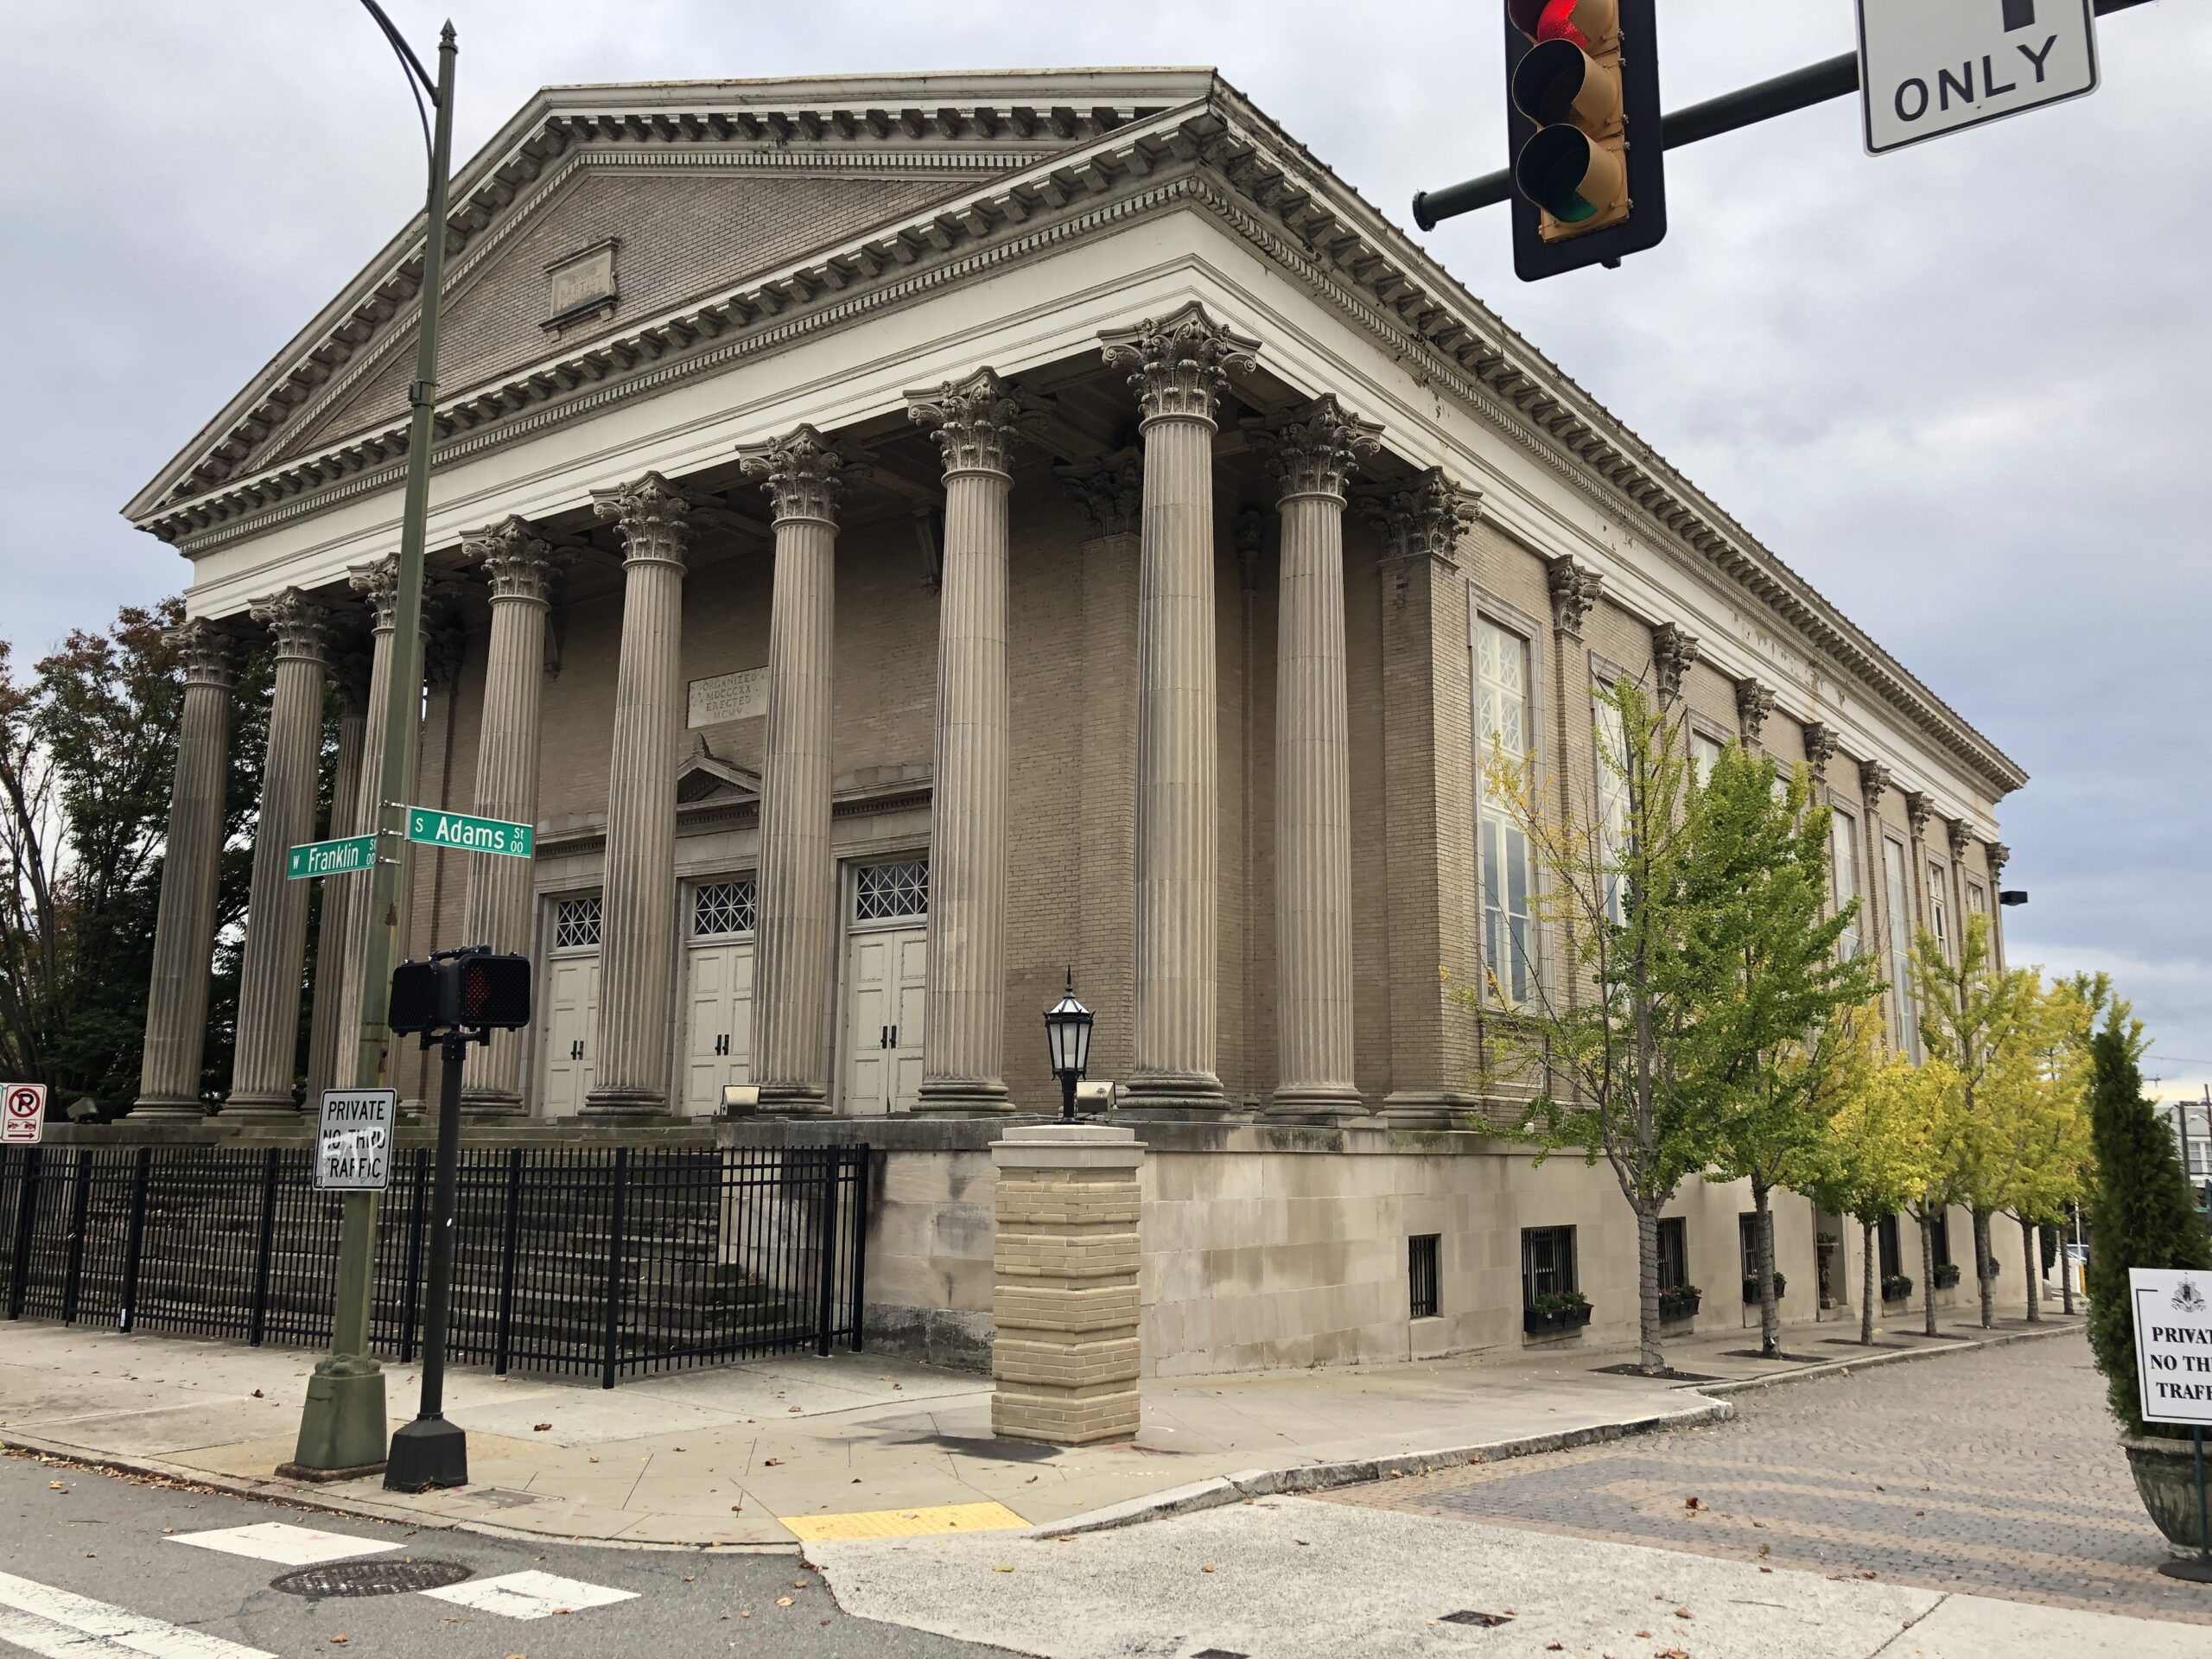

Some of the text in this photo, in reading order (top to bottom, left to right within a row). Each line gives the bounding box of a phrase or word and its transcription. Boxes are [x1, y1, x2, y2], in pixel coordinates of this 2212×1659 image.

[1894, 34, 2058, 122] ONLY
[702, 674, 757, 691] ORGANIZED
[706, 684, 751, 701] MDCCCXX
[706, 696, 751, 711] ERECTED
[415, 816, 524, 849] S Adams St
[510, 840, 524, 853] 00
[293, 855, 300, 870] W
[308, 842, 359, 873] Franklin
[327, 1100, 386, 1121] PRIVATE
[323, 1128, 341, 1149] NO
[327, 1157, 382, 1178] RAFFIC
[2150, 1354, 2212, 1373] NO TH
